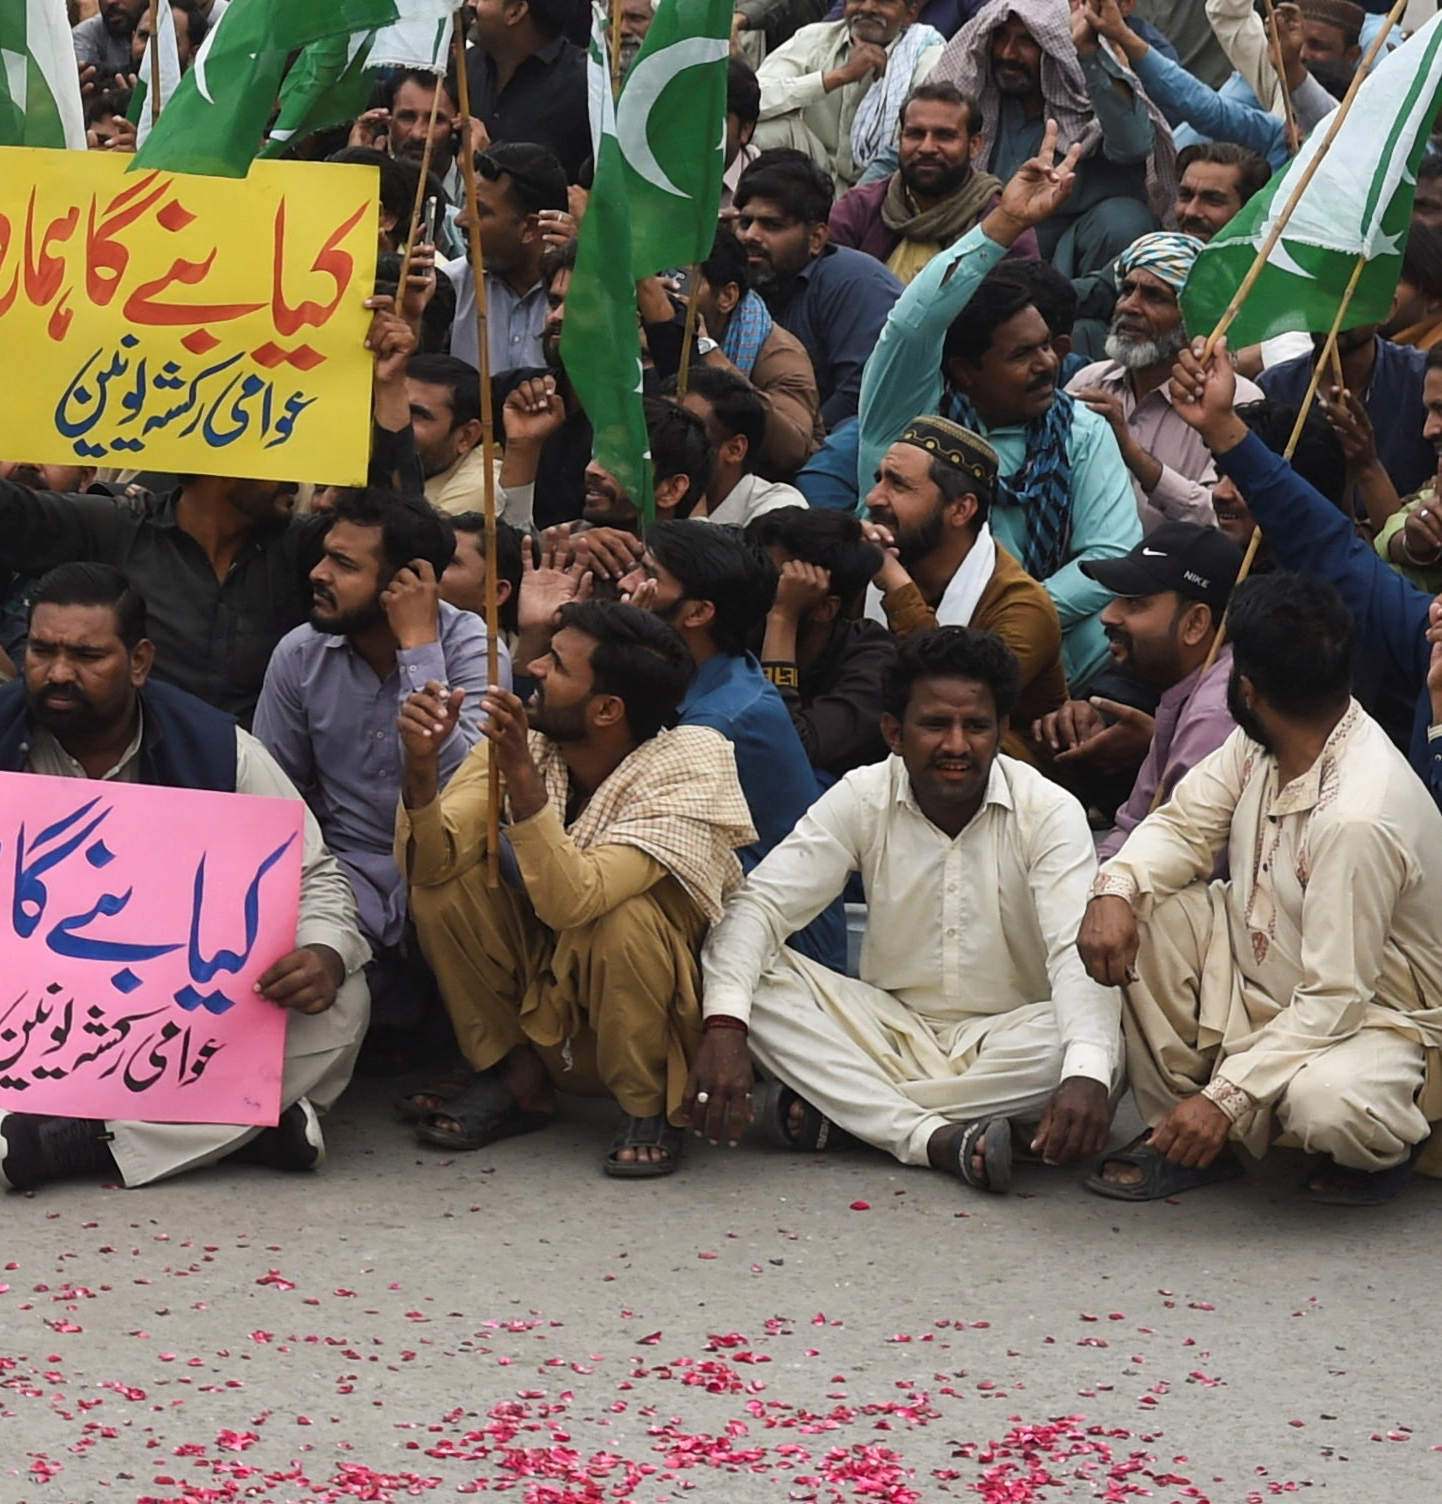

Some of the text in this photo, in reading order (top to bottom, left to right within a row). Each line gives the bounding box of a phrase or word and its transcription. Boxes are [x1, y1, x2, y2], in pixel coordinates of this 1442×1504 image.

[85, 169, 175, 307] گا
[122, 199, 271, 356] بنے
[250, 194, 371, 373] کیا
[54, 333, 320, 460] عوامی رکشہ یونین
[1183, 569, 1210, 589] NIKE
[12, 795, 114, 939] گا
[45, 838, 188, 995] بنے
[174, 830, 299, 1016] کیا
[70, 1004, 173, 1081] رکشہ
[123, 1020, 228, 1093] عوامی
